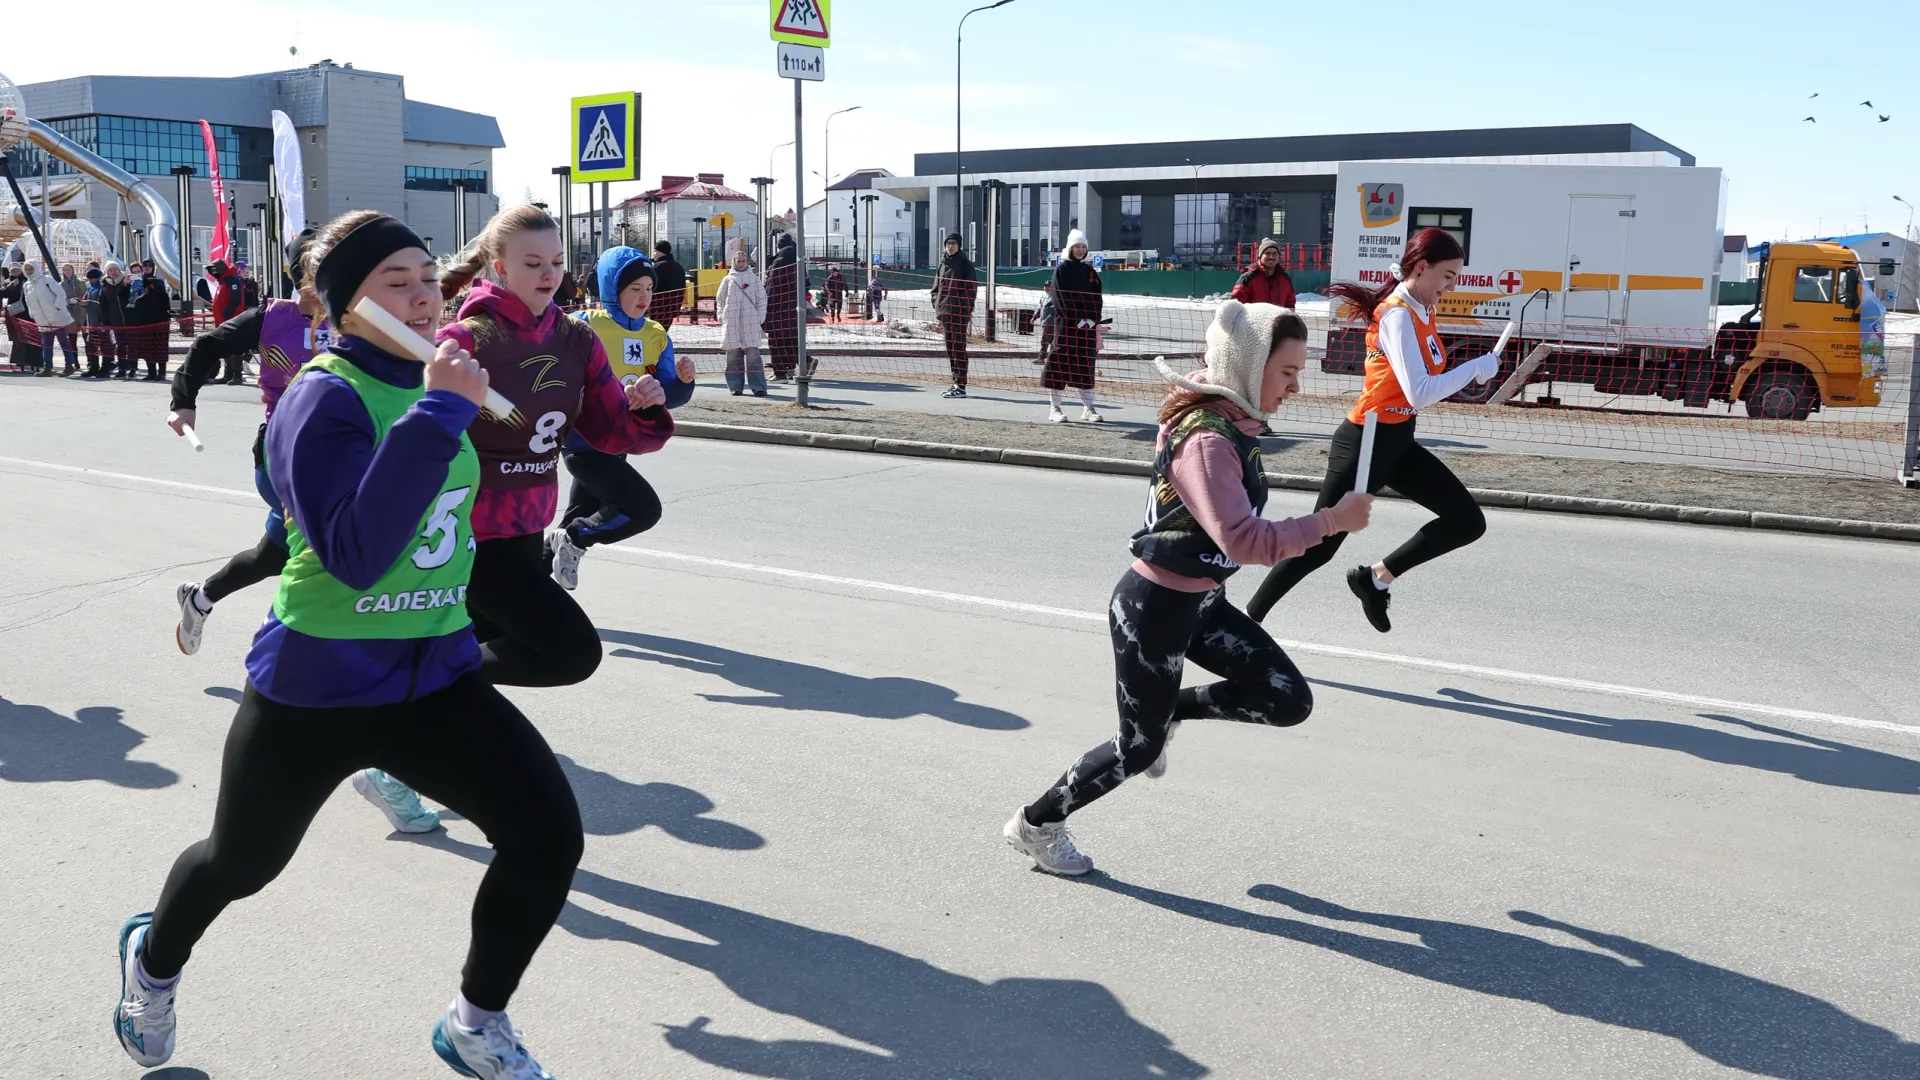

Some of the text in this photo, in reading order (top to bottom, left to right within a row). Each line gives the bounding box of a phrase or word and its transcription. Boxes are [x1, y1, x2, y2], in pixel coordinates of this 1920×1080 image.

[1359, 270, 1494, 287] МЕДИ ЛУЖБА
[1438, 298, 1511, 307] ЛЮОРОГРАФИЧЕСКИЙ
[1441, 307, 1511, 316] ИФРОВОЙ
[528, 410, 567, 454] 8
[410, 484, 471, 571] 5
[354, 584, 467, 614] САЛЕХАР
